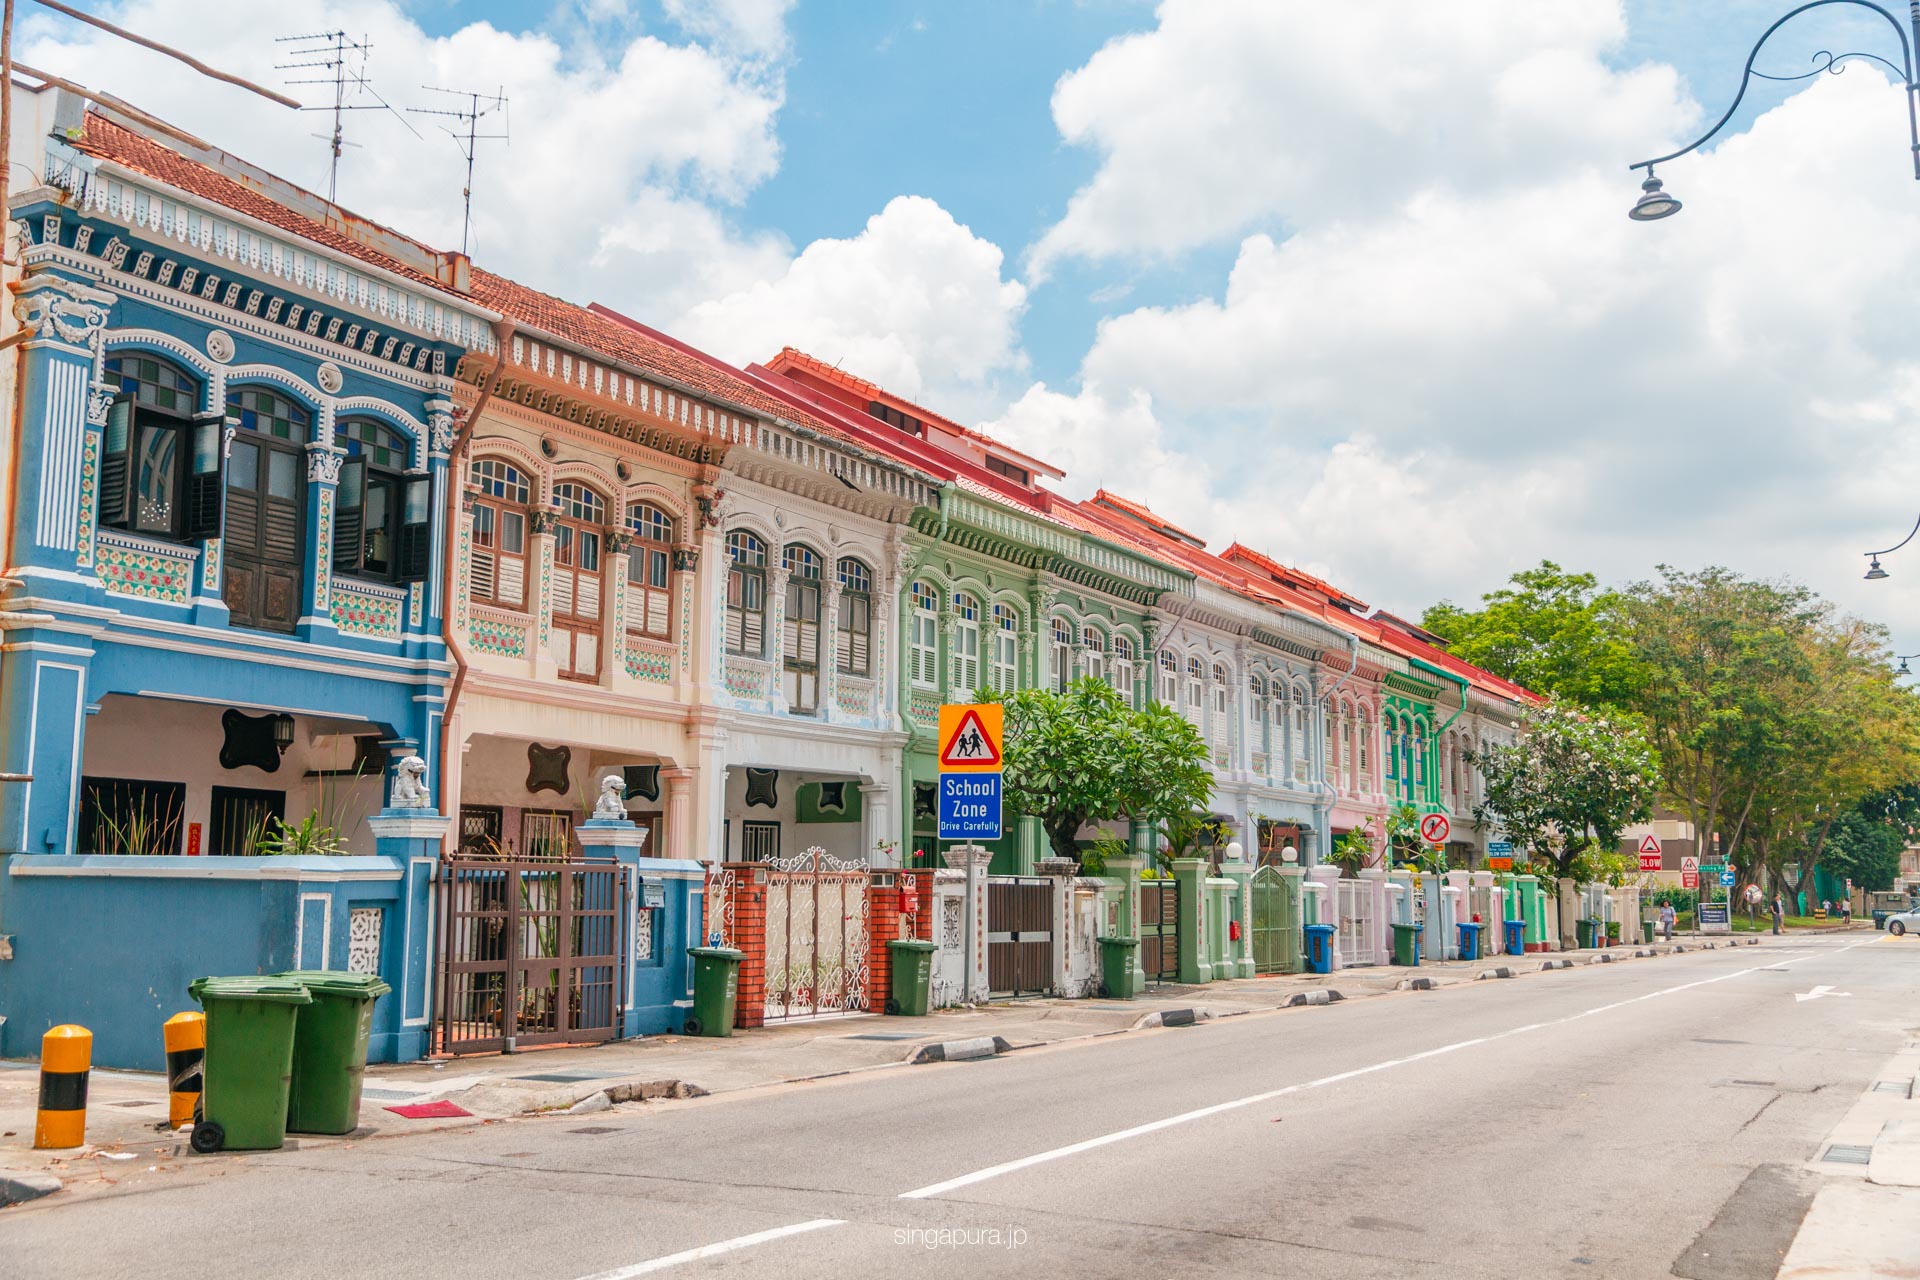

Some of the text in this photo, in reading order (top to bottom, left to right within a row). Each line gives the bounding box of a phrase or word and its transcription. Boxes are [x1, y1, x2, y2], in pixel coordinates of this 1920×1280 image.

[946, 779, 995, 796] School
[953, 800, 987, 817] Zone
[941, 821, 999, 832] Drive Carefully
[1640, 858, 1661, 867] SLOW
